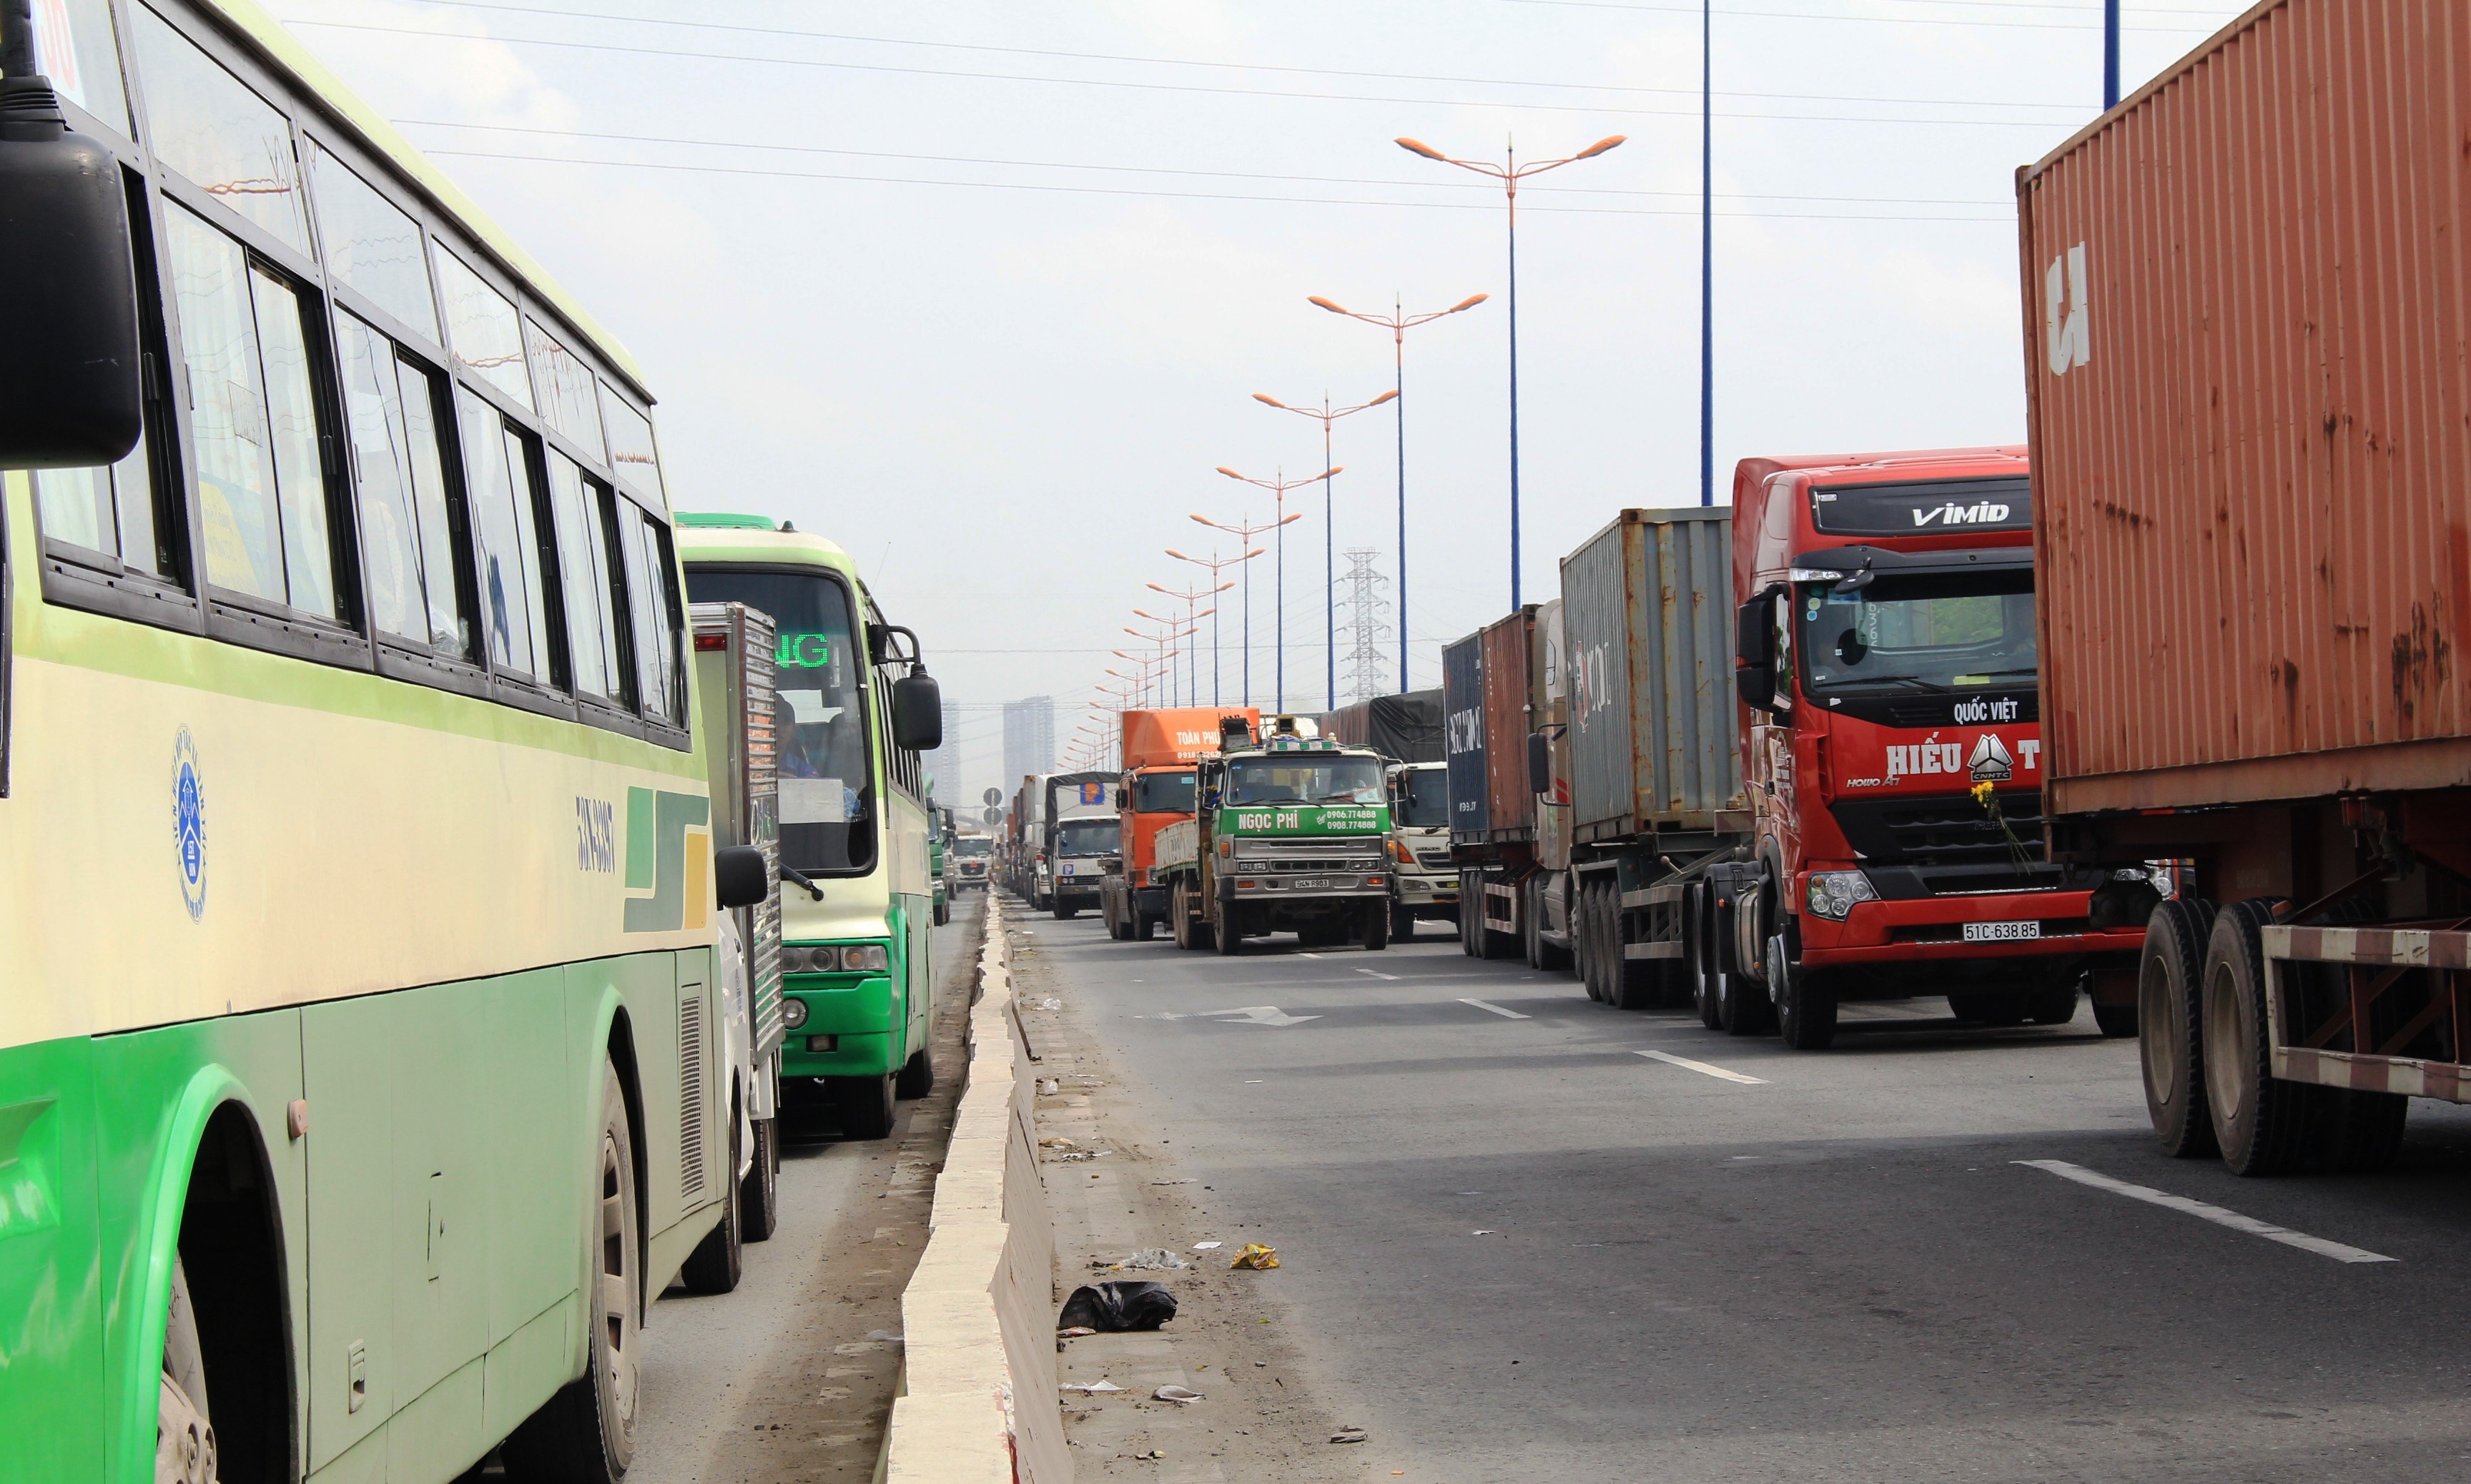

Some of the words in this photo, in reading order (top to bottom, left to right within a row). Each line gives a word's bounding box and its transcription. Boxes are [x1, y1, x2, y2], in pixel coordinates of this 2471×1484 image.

[1954, 696, 1987, 725] QUỐC
[1990, 697, 2018, 723] VIỆT
[1176, 728, 1200, 746] TOÀN
[1886, 731, 1962, 775] HIẾU
[1847, 778, 1881, 788] HOWO
[1882, 774, 1900, 786] A7
[1238, 813, 1272, 833] NGỌC
[1327, 821, 1376, 829] 0908.774888
[1966, 923, 2038, 939] 51C-638.85
